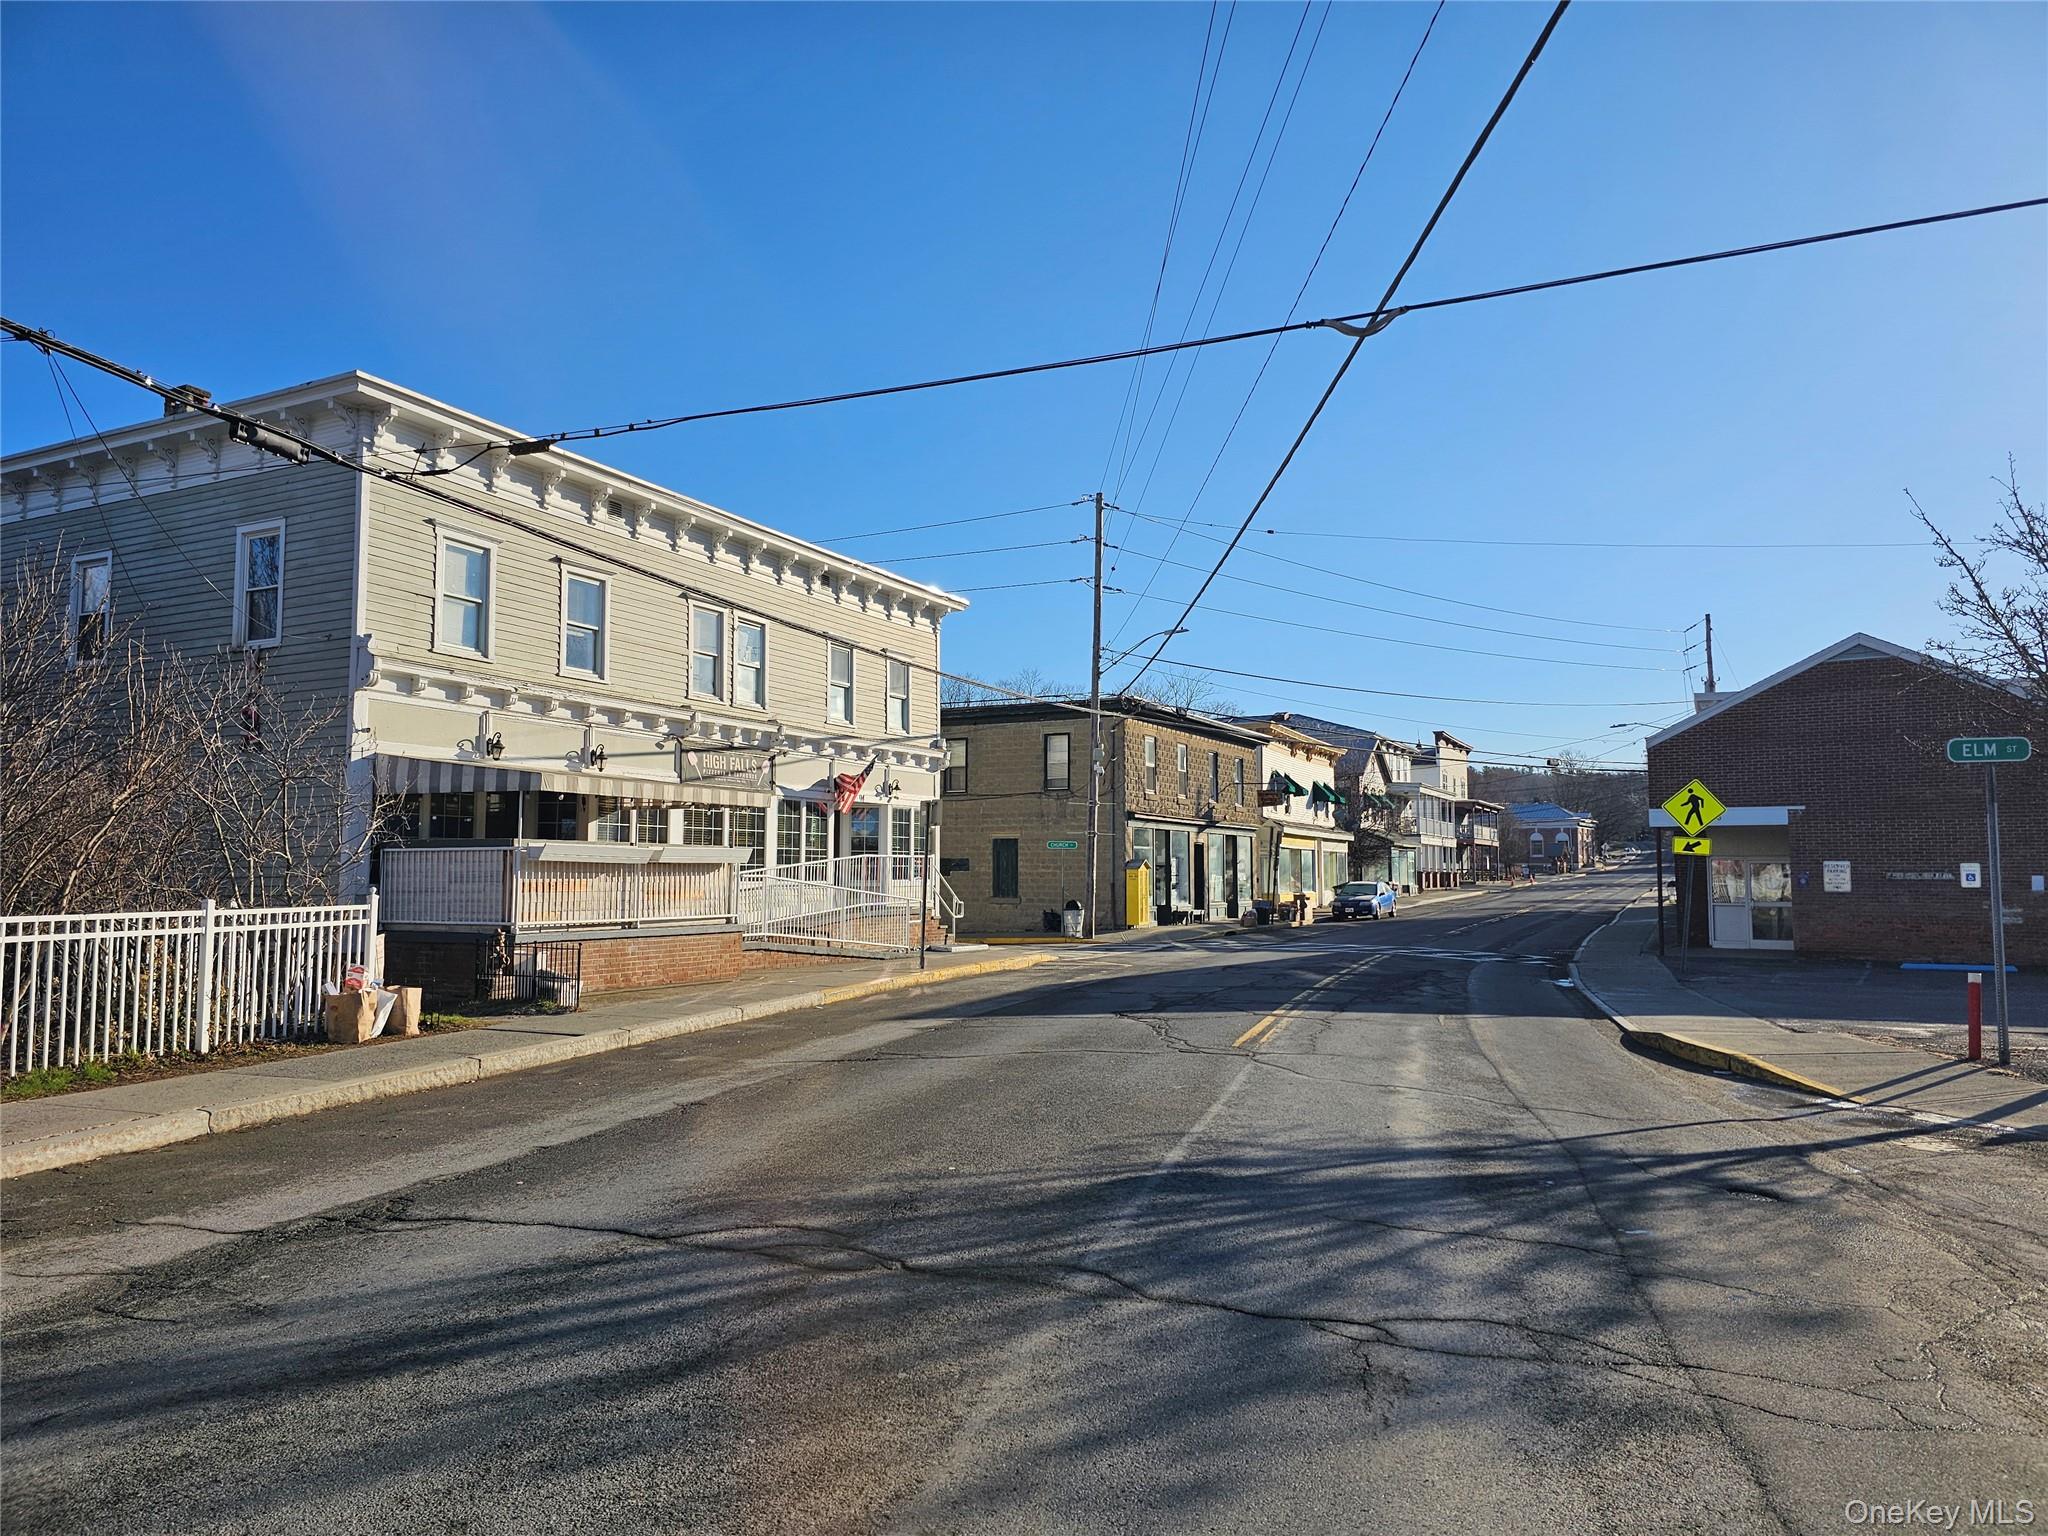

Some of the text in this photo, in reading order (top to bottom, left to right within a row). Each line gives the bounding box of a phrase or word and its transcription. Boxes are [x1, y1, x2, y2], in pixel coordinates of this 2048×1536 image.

[1962, 743, 2017, 757] ELM ST
[703, 754, 757, 773] HIGH FALLS
